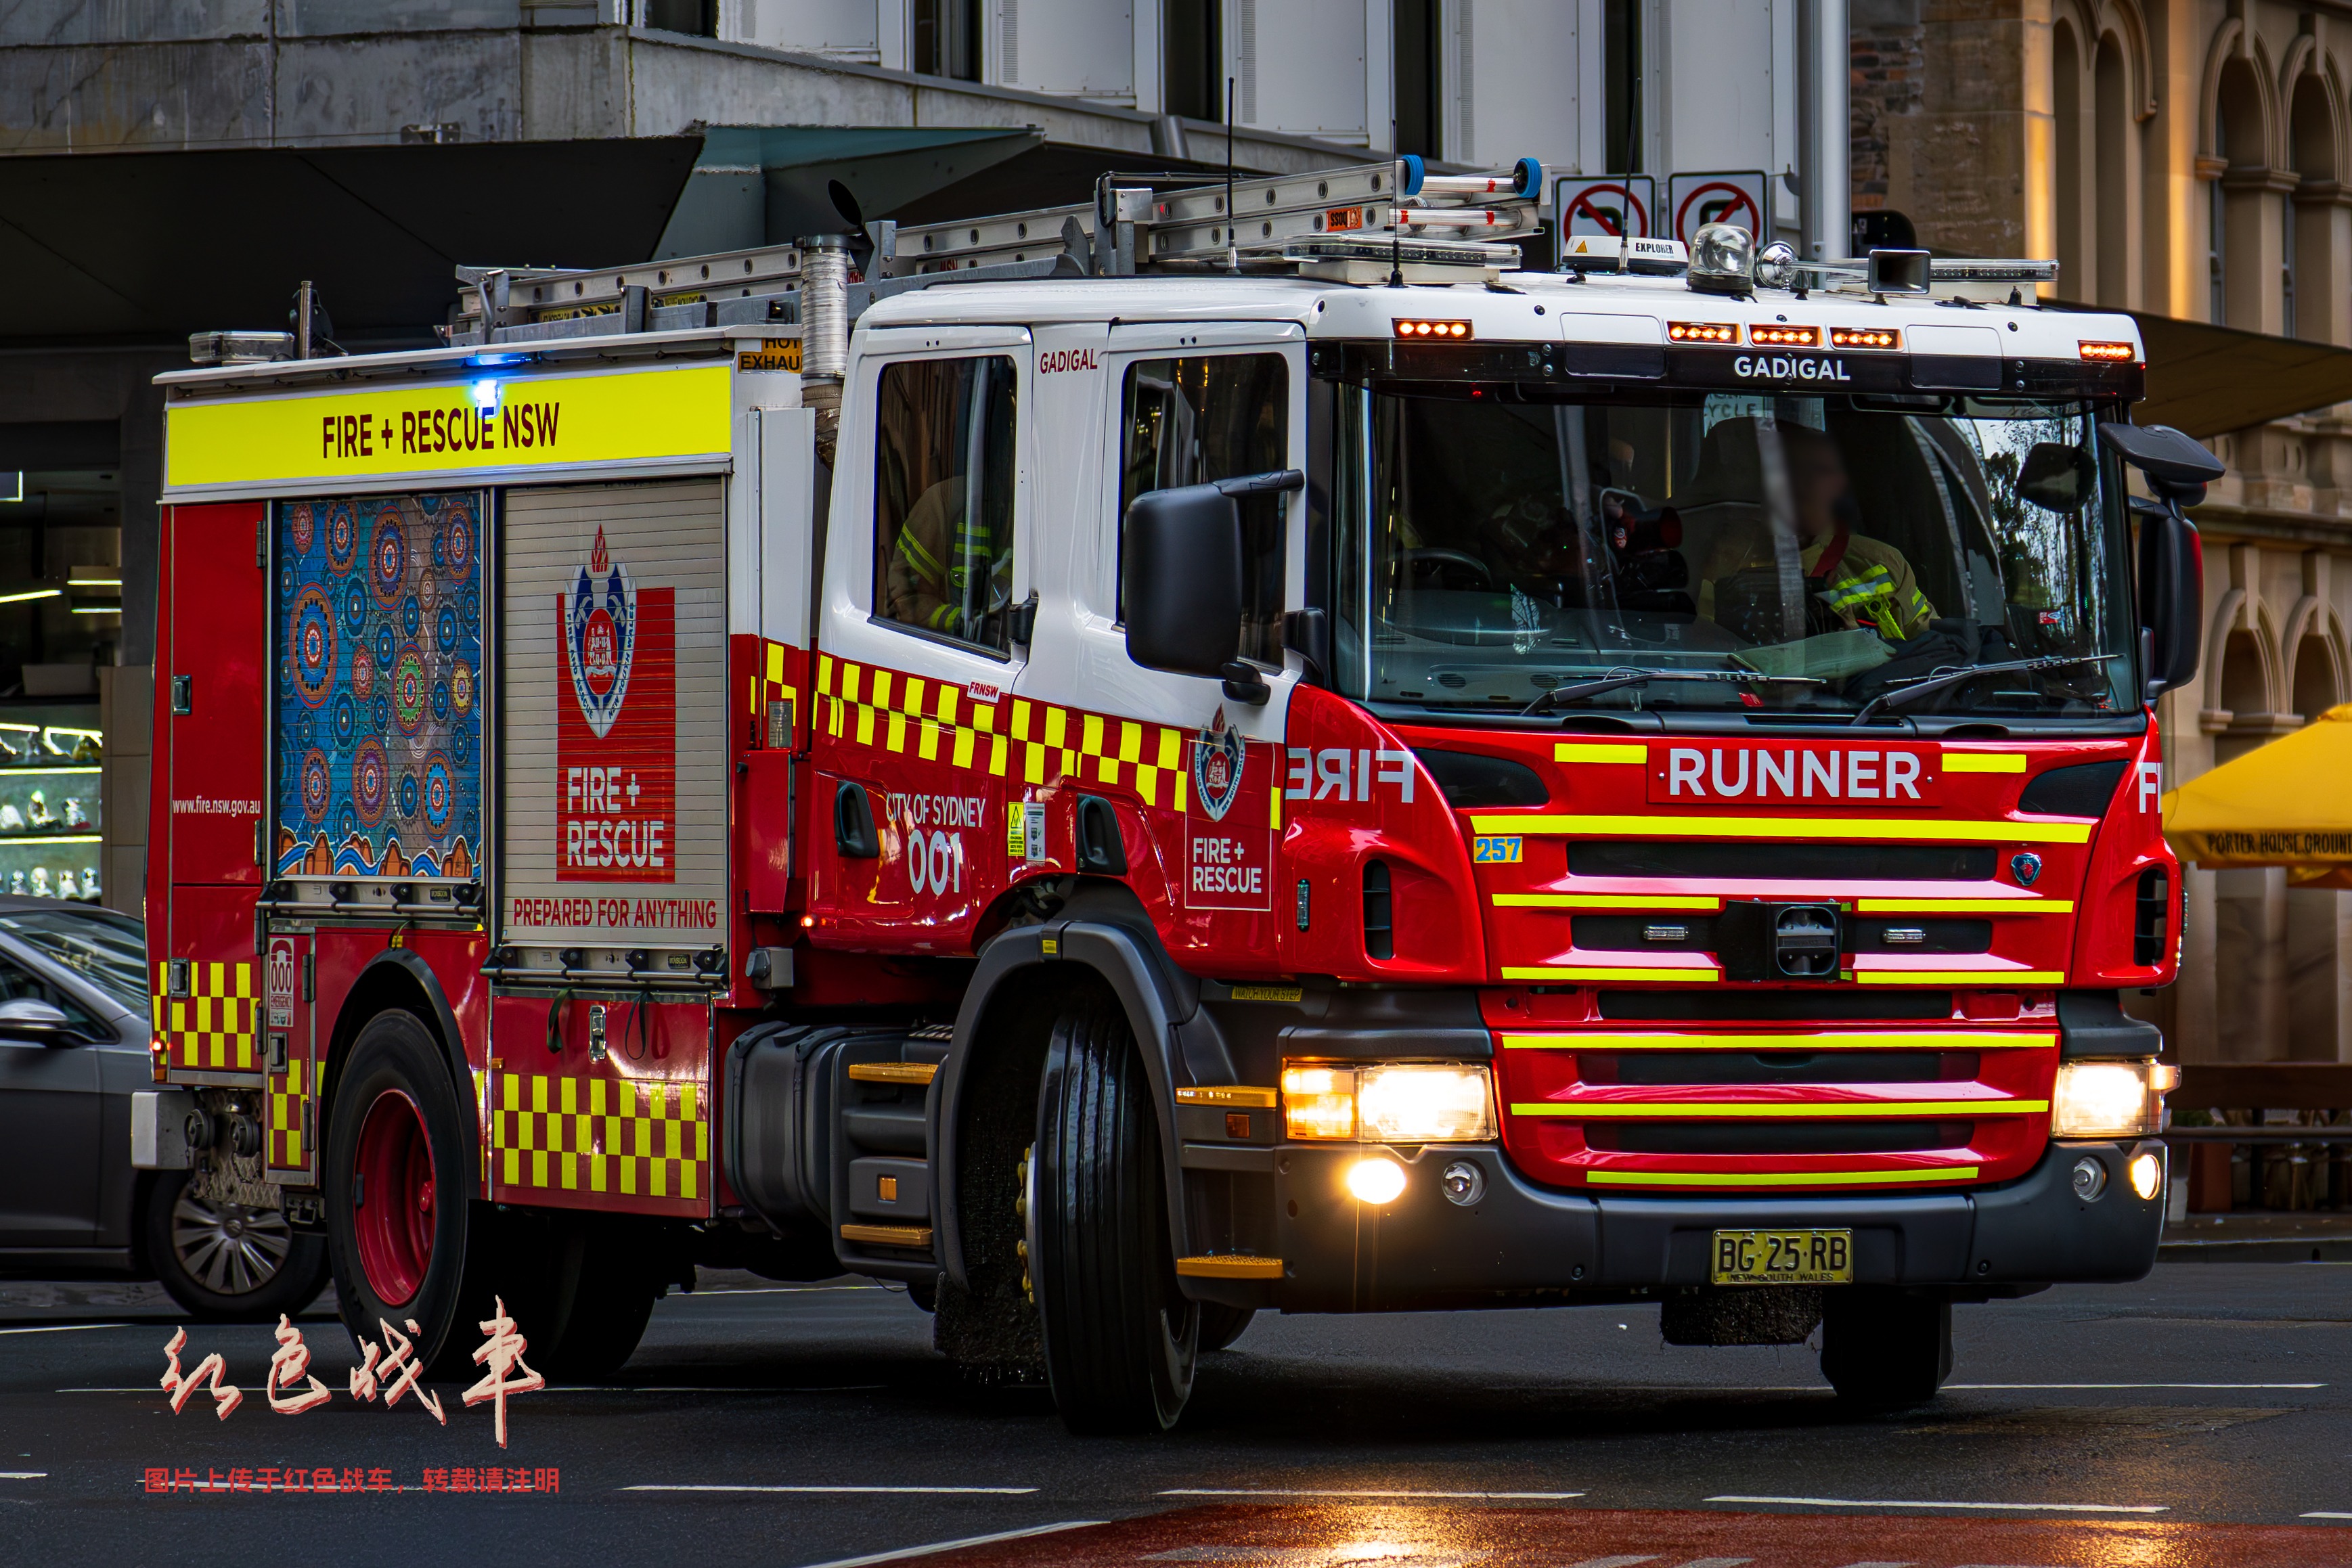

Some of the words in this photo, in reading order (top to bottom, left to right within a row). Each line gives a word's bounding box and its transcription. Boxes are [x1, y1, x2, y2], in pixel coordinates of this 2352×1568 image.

[1635, 242, 1674, 254] EXPLORER
[740, 355, 801, 371] EXHAU
[1040, 348, 1098, 374] GADIGAL
[1734, 356, 1851, 381] GADIGAL
[323, 414, 373, 459] FIRE
[381, 418, 393, 449] +
[402, 407, 495, 454] RESCUE
[503, 402, 560, 449] NSW
[969, 681, 999, 699] FRNSW
[1670, 748, 1922, 799] RUNNER
[567, 767, 621, 813] FIRE
[626, 774, 640, 807] +
[173, 795, 261, 817] www.fire.nsw.gov.au
[886, 793, 911, 822] CITY
[914, 794, 930, 824] OF
[933, 795, 986, 828] SYDNEY
[567, 820, 664, 867] RESCUE
[1193, 838, 1230, 863] FIRE
[1234, 842, 1244, 860] +
[1476, 838, 1522, 861] 257
[2206, 832, 2255, 853] PORTER
[2261, 832, 2300, 853] HOUSE
[908, 829, 960, 896] 001
[1193, 866, 1262, 893] RESCUE
[514, 899, 592, 926] PREPARED
[597, 899, 629, 927] FOR
[634, 899, 716, 928] ANYTHING
[271, 962, 292, 993] 000
[1718, 1238, 1756, 1272] BG
[1766, 1236, 1801, 1271] 25
[1811, 1236, 1847, 1271] RB
[1760, 1273, 1794, 1281] SOUTH
[1800, 1273, 1834, 1281] WALES
